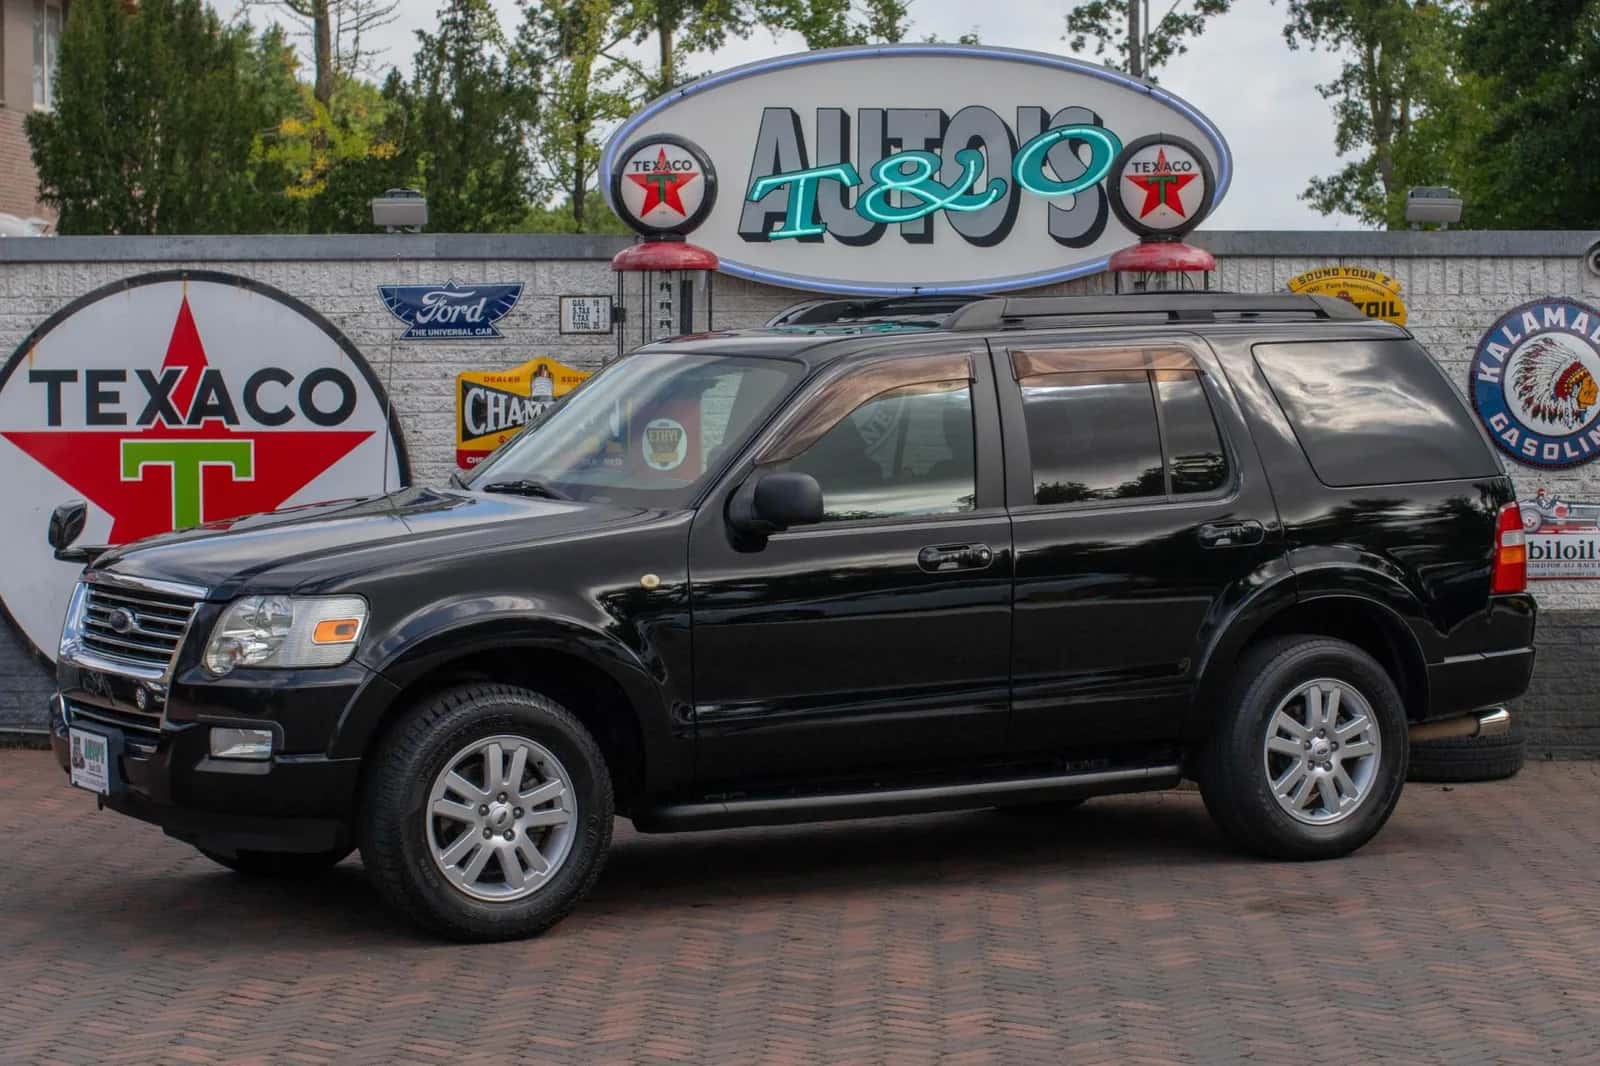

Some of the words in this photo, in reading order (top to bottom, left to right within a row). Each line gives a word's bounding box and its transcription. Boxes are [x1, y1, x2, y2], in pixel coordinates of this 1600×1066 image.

[633, 160, 692, 171] TEXACO
[738, 105, 1108, 248] AUTO'S
[1132, 161, 1192, 173] TEXACO
[647, 174, 677, 202] T
[1147, 175, 1176, 203] T
[1298, 268, 1339, 285] SOUND
[1343, 267, 1377, 279] YOUR
[415, 291, 487, 324] Ford
[411, 329, 427, 337] THE
[428, 328, 472, 336] UNIVERSAL
[475, 327, 492, 336] CAR
[484, 376, 521, 384] DEALER
[29, 367, 357, 426] TEXACO
[464, 387, 558, 435] CHAM
[1528, 540, 1595, 560] biloil
